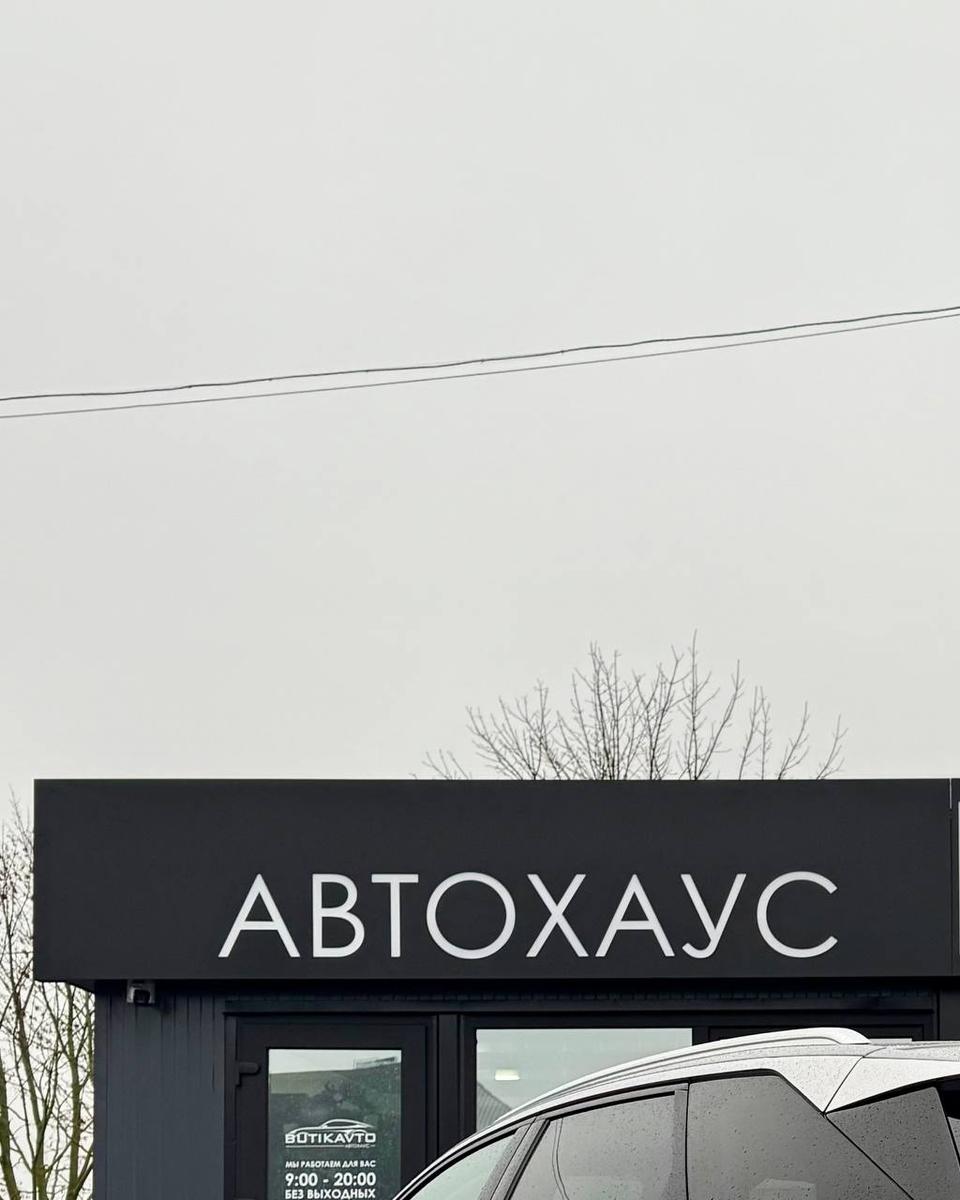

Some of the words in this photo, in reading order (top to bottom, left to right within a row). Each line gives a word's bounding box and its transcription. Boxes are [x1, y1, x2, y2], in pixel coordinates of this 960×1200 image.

[217, 871, 839, 960] АВТОХАУС
[285, 1132, 377, 1144] BUTIKAVTO
[285, 1161, 299, 1169] МЫ
[300, 1160, 341, 1168] РАБОТАЕМ
[342, 1160, 358, 1169] ДЛЯ
[359, 1160, 377, 1168] ВАС
[285, 1172, 319, 1187] 9:00
[333, 1171, 377, 1187] 20:00
[285, 1189, 304, 1200] БЕЗ
[306, 1188, 377, 1200] ВЫХОДНЫХ
